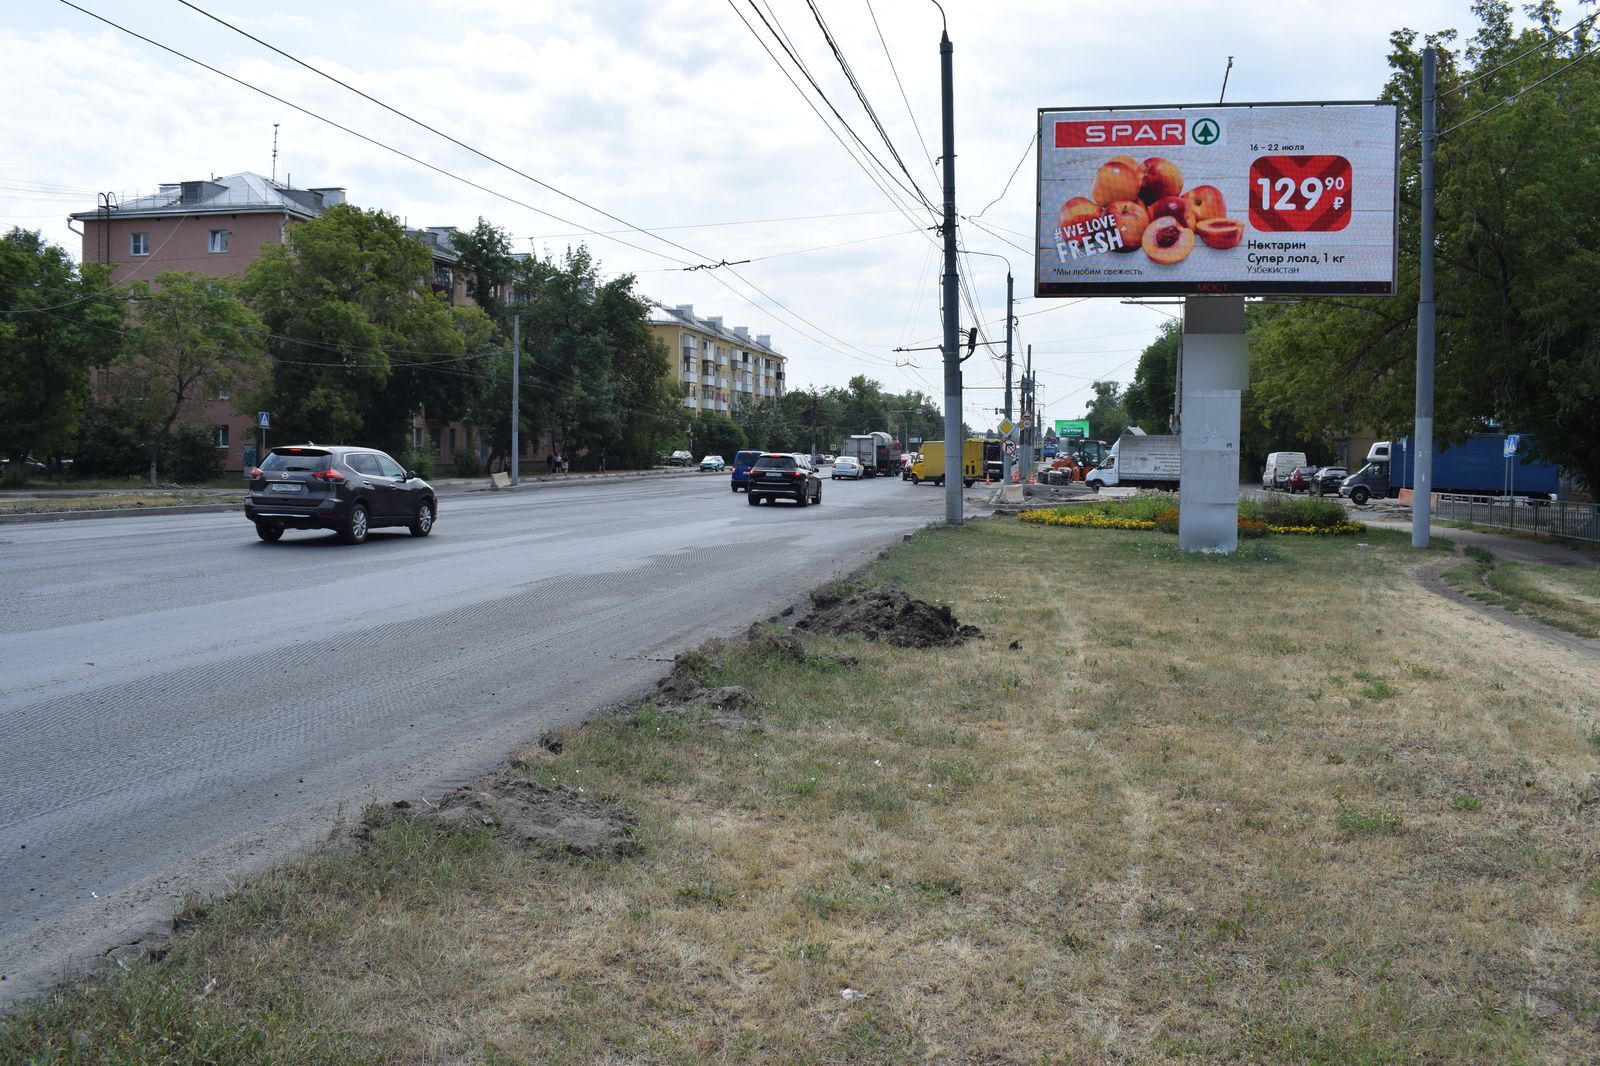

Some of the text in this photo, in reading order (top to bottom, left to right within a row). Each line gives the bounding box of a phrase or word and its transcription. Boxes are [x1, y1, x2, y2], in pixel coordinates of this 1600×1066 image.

[1085, 124, 1183, 142] SPAR
[1250, 143, 1259, 151] 16
[1267, 143, 1279, 151] 22
[1257, 177, 1344, 210] 129 90
[1085, 214, 1117, 234] LOVE
[1247, 240, 1306, 251] Нектарин
[1247, 252, 1346, 265] Супер лола, 1 кг
[1072, 267, 1102, 276] любим
[1246, 265, 1300, 274] Узбекистан
